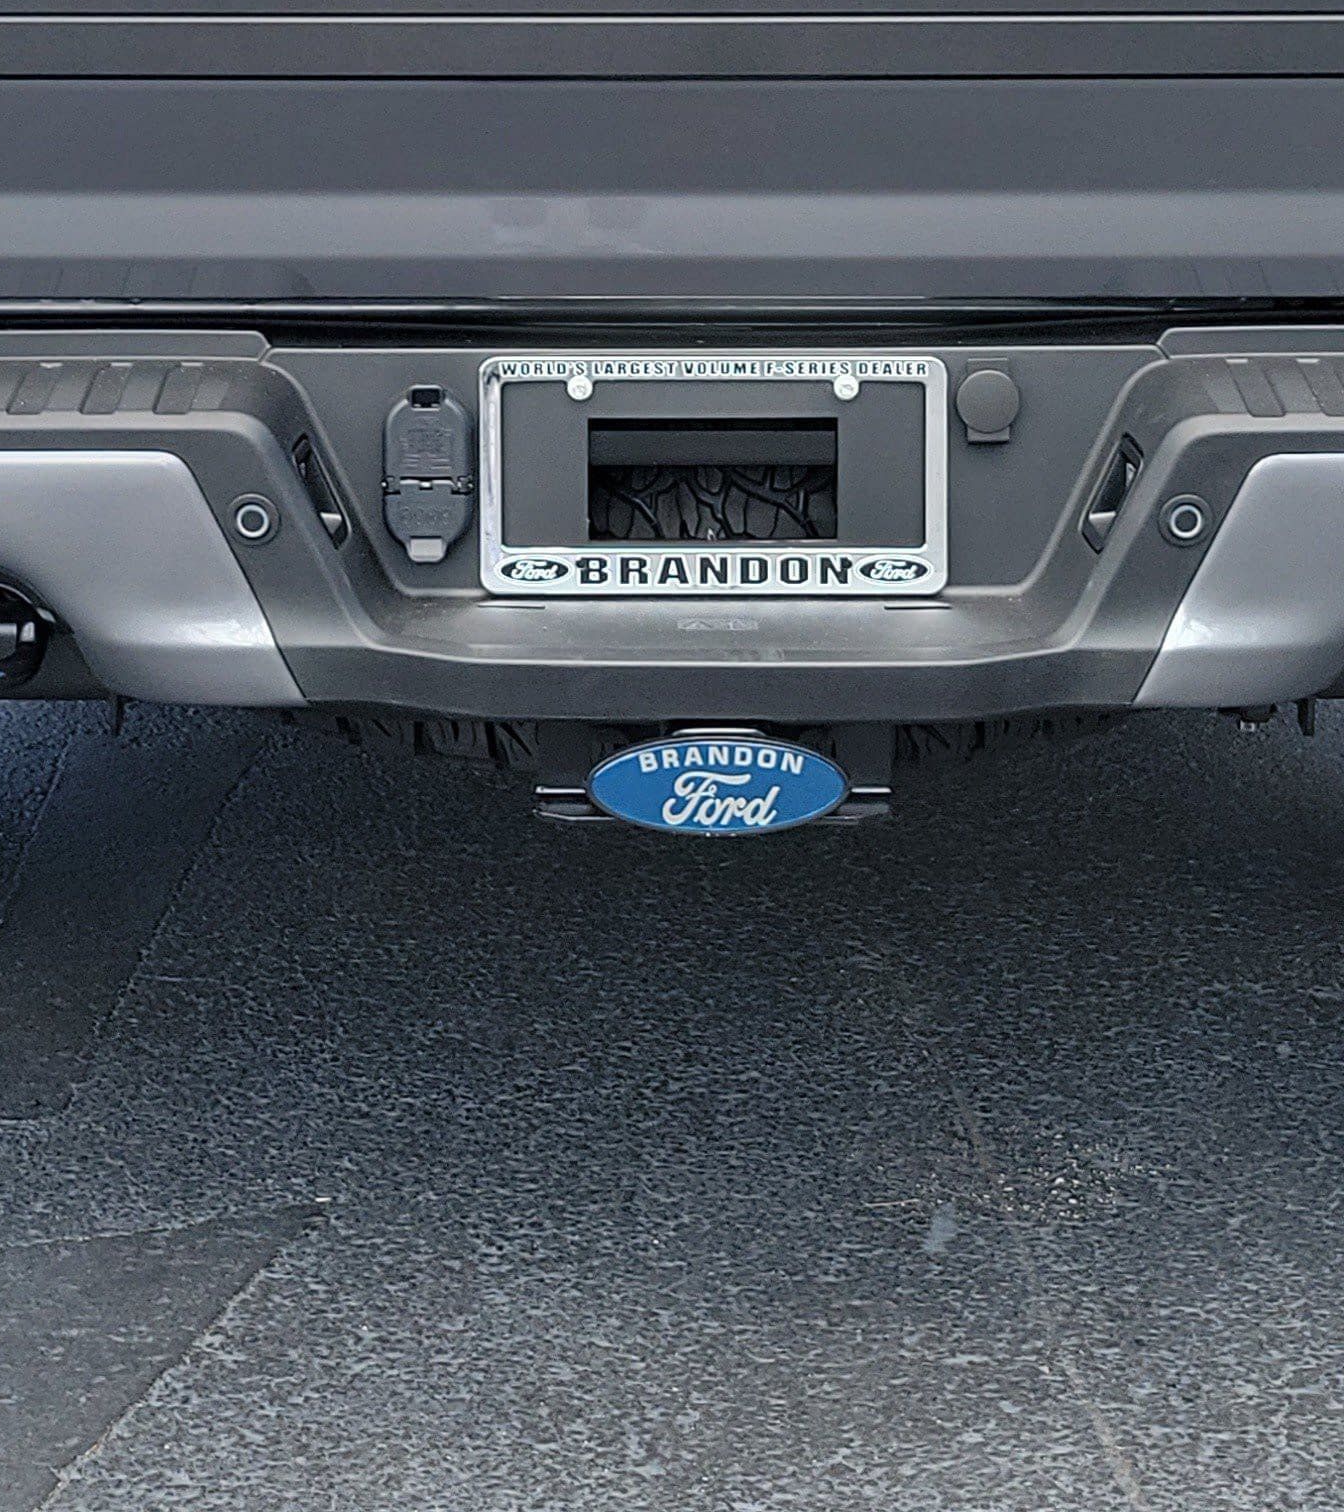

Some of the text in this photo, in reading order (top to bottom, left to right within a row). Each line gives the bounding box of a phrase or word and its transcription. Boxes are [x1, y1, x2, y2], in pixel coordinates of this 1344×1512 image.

[501, 361, 928, 376] WORLD'S LARGEST VOLUME F-SERIES DEALER
[511, 556, 917, 586] Ford BRANDON Ford
[639, 746, 803, 774] BRANDON
[662, 771, 780, 827] Ford
